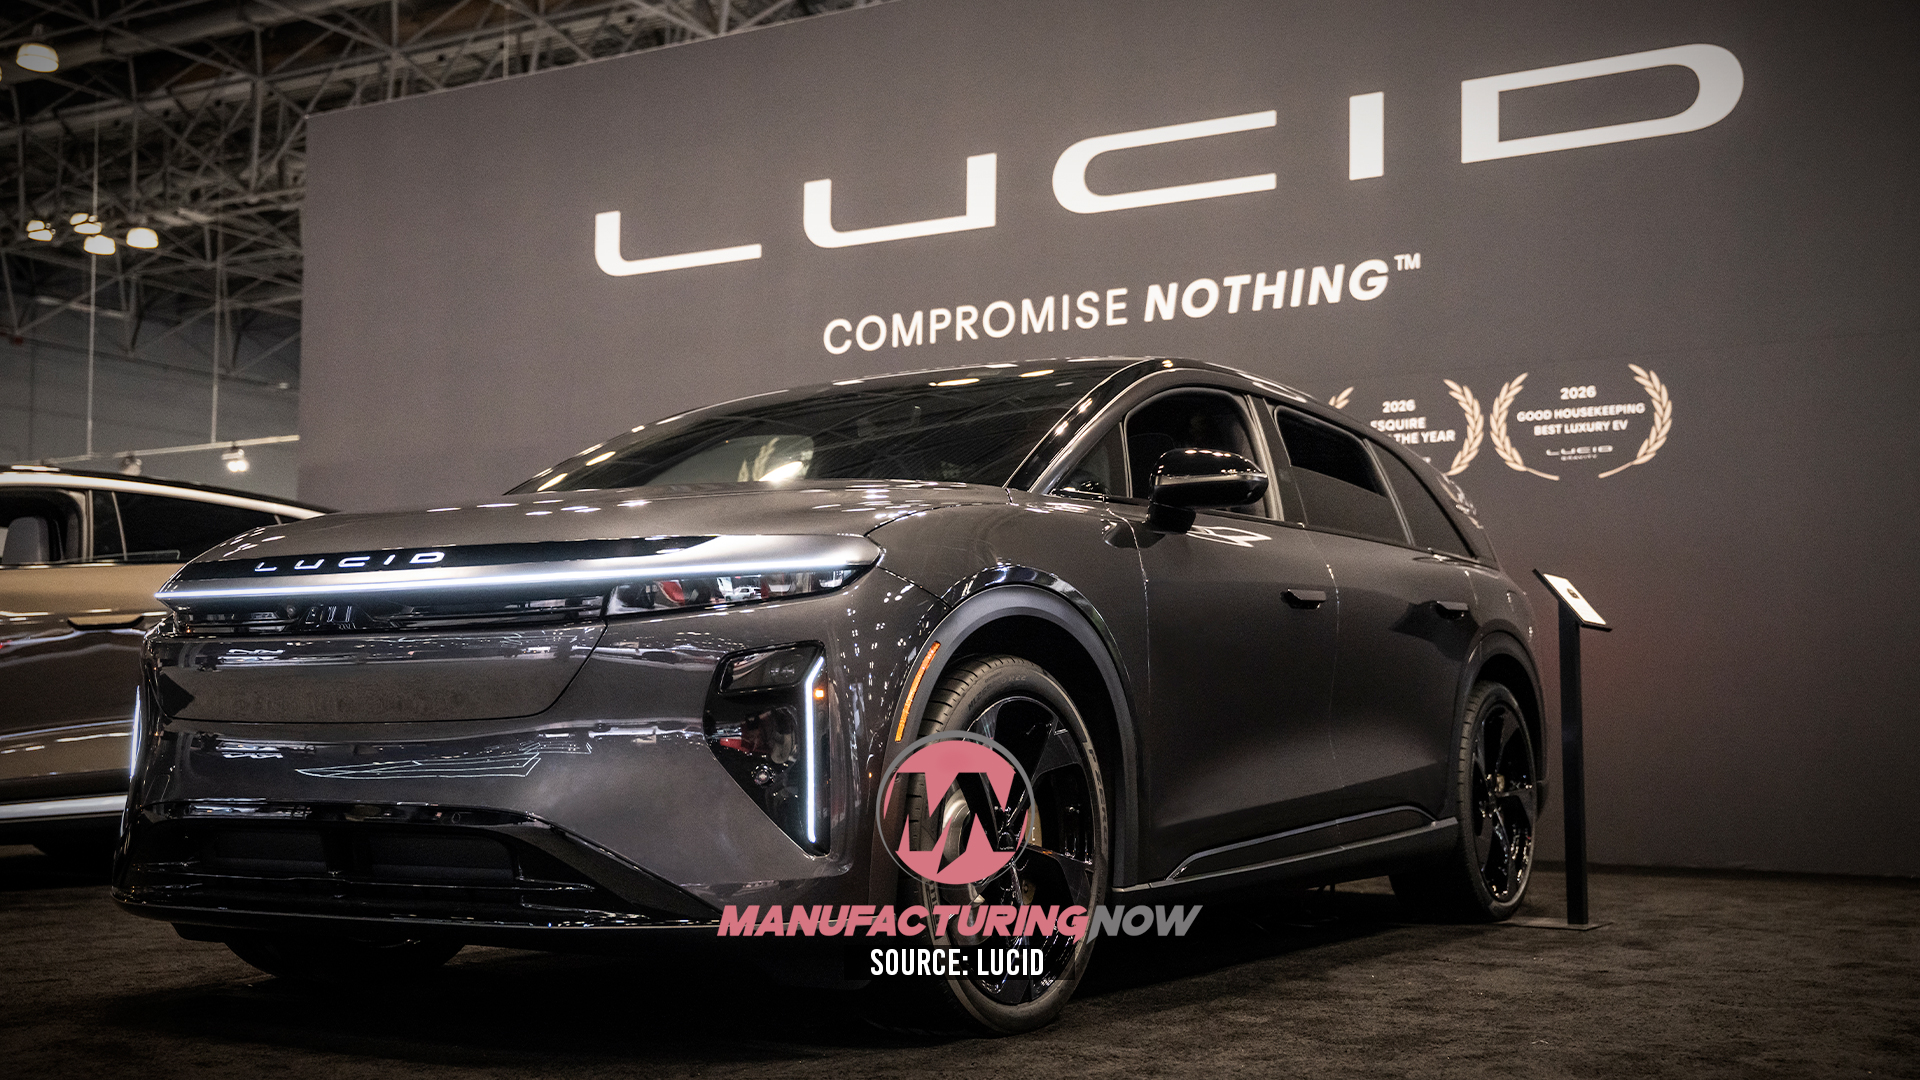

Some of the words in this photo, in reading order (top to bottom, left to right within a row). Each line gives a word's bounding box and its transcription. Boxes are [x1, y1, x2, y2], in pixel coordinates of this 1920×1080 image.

[594, 43, 1744, 277] LUCID
[822, 287, 1129, 355] COMPROMISE
[1560, 385, 1597, 400] 2026
[1382, 399, 1417, 414] 2026
[1516, 410, 1553, 422] GOOD
[1553, 402, 1646, 420] HOUSEKEEPING
[1533, 423, 1563, 436] BEST
[1563, 421, 1611, 434] LUXURY
[1612, 419, 1629, 431] EV
[1393, 432, 1420, 445] THE
[1420, 429, 1456, 443] YEAR
[254, 551, 446, 573] LUCID
